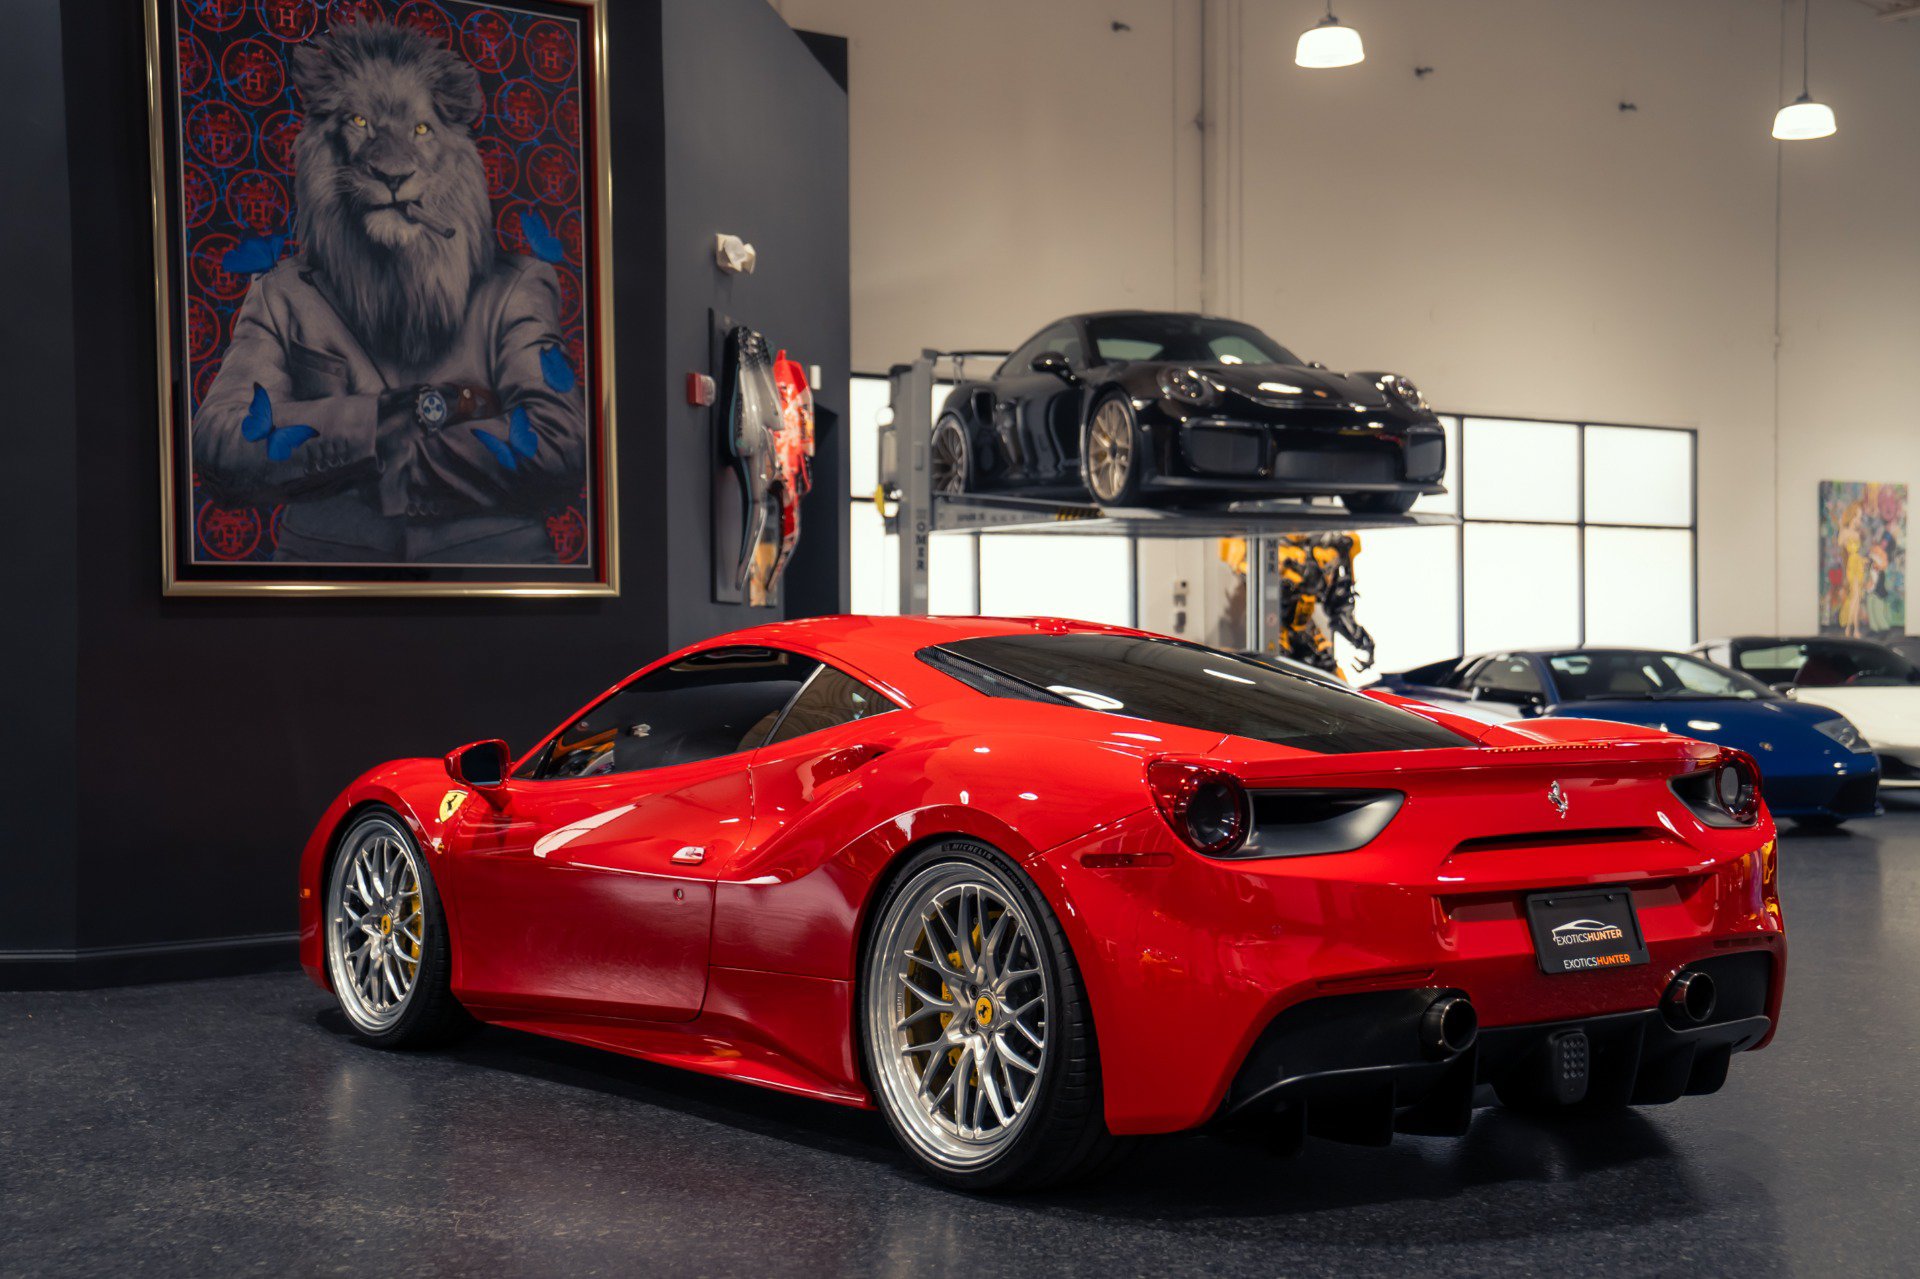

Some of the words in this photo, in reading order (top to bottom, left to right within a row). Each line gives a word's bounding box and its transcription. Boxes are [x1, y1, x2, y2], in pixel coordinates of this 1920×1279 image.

[279, 7, 295, 29] H
[543, 50, 560, 69] H
[245, 72, 261, 92] H
[513, 110, 529, 128] H
[951, 843, 994, 860] MICHELIN
[1556, 929, 1623, 946] EXOTICSHUNTER
[1563, 953, 1631, 970] EXOTICSHUNTER
